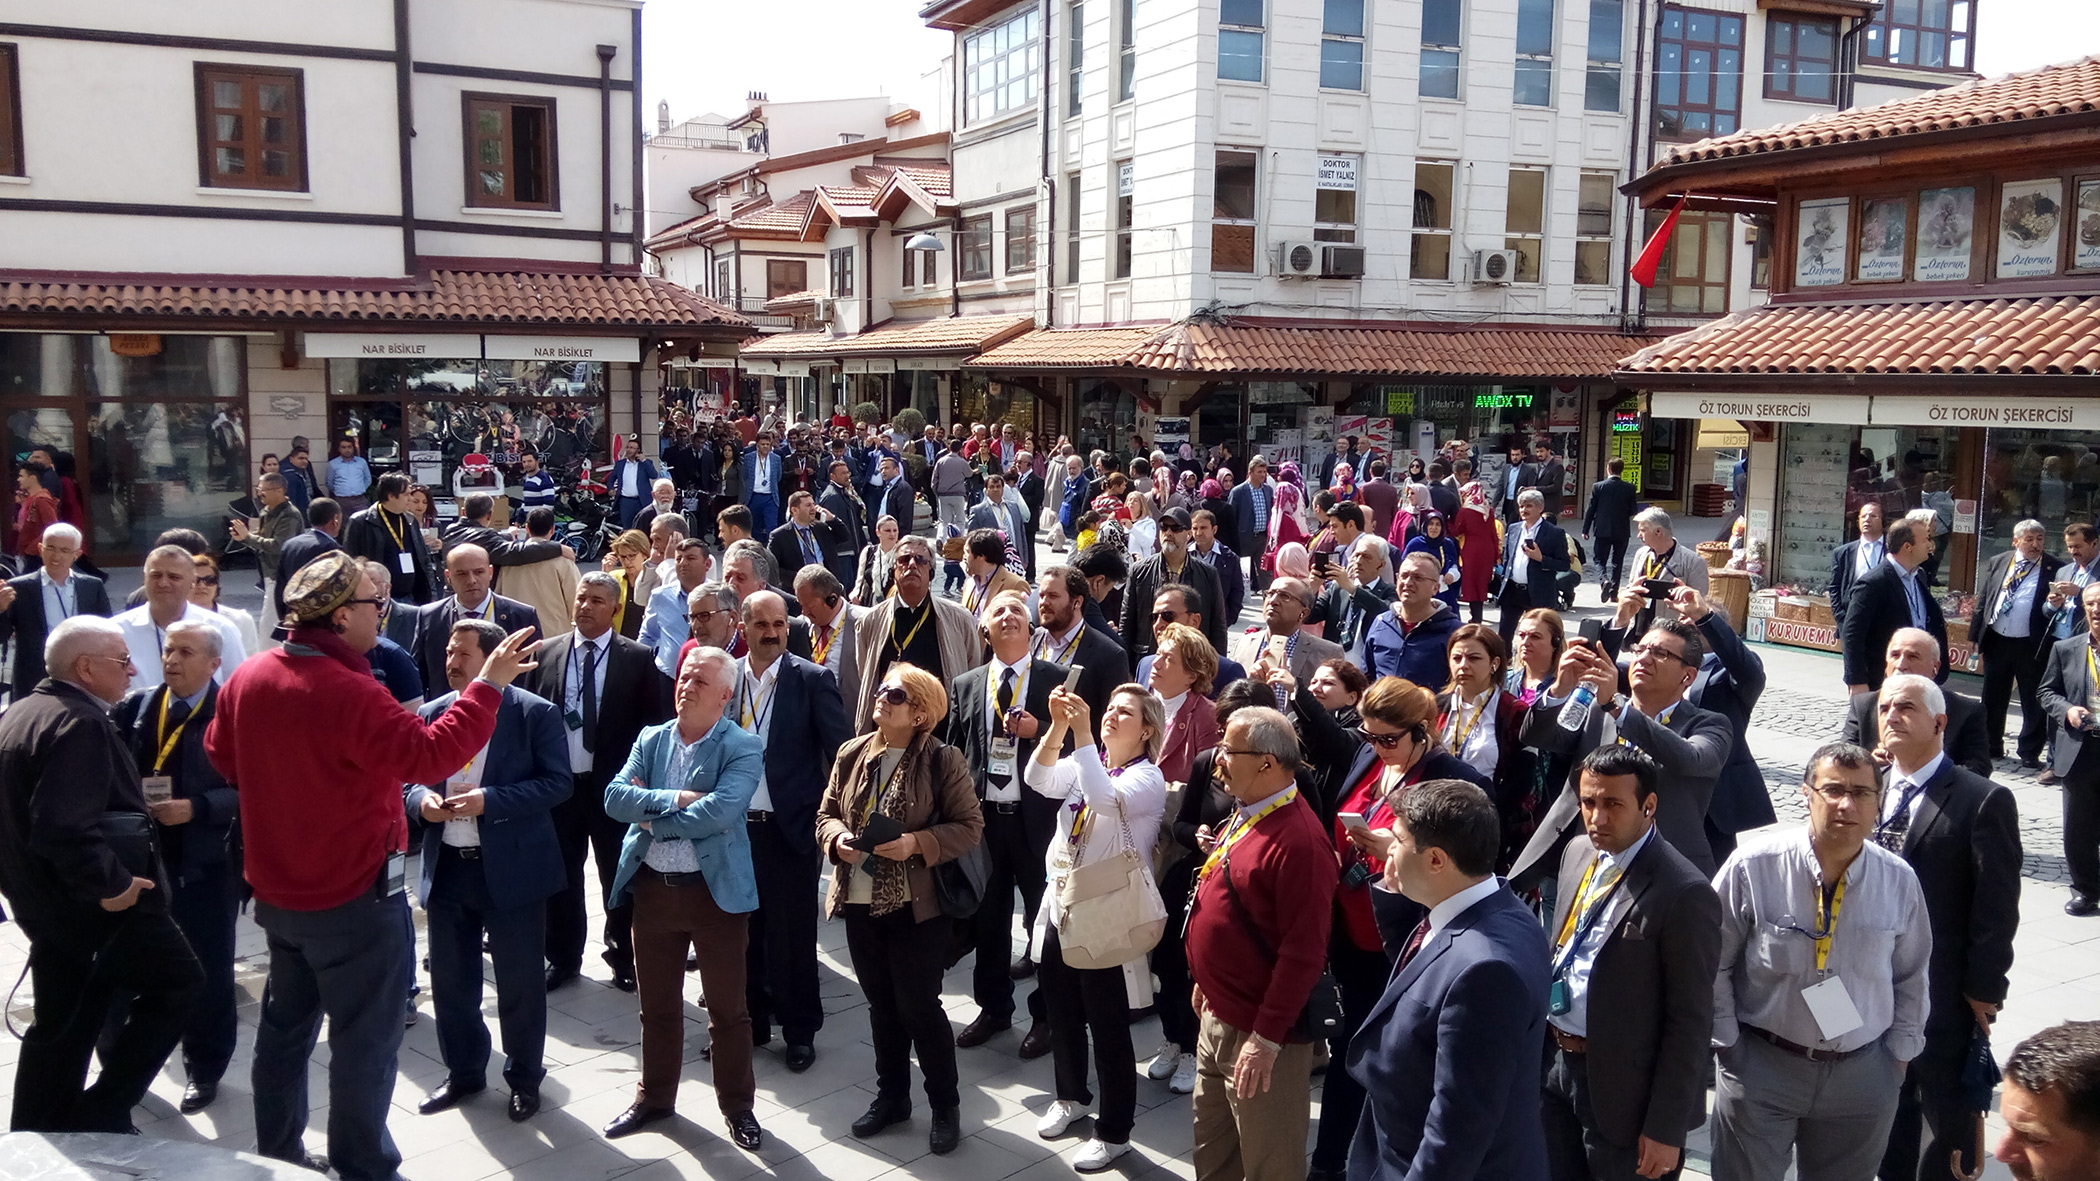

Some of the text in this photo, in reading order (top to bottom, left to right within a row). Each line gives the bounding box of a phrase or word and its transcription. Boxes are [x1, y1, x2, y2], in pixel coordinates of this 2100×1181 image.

[1323, 160, 1351, 168] DOKTOR
[362, 343, 426, 354] NAR BİSİKLET
[534, 346, 593, 358] NAR BİSİKLET
[1475, 395, 1513, 408] AWOX
[1515, 394, 1533, 407] TV
[1699, 400, 1811, 418] ÖZ TORUN ŞEKERCİSİ
[1929, 404, 2074, 424] ÖZ TORUN ŞEKERCİSİ
